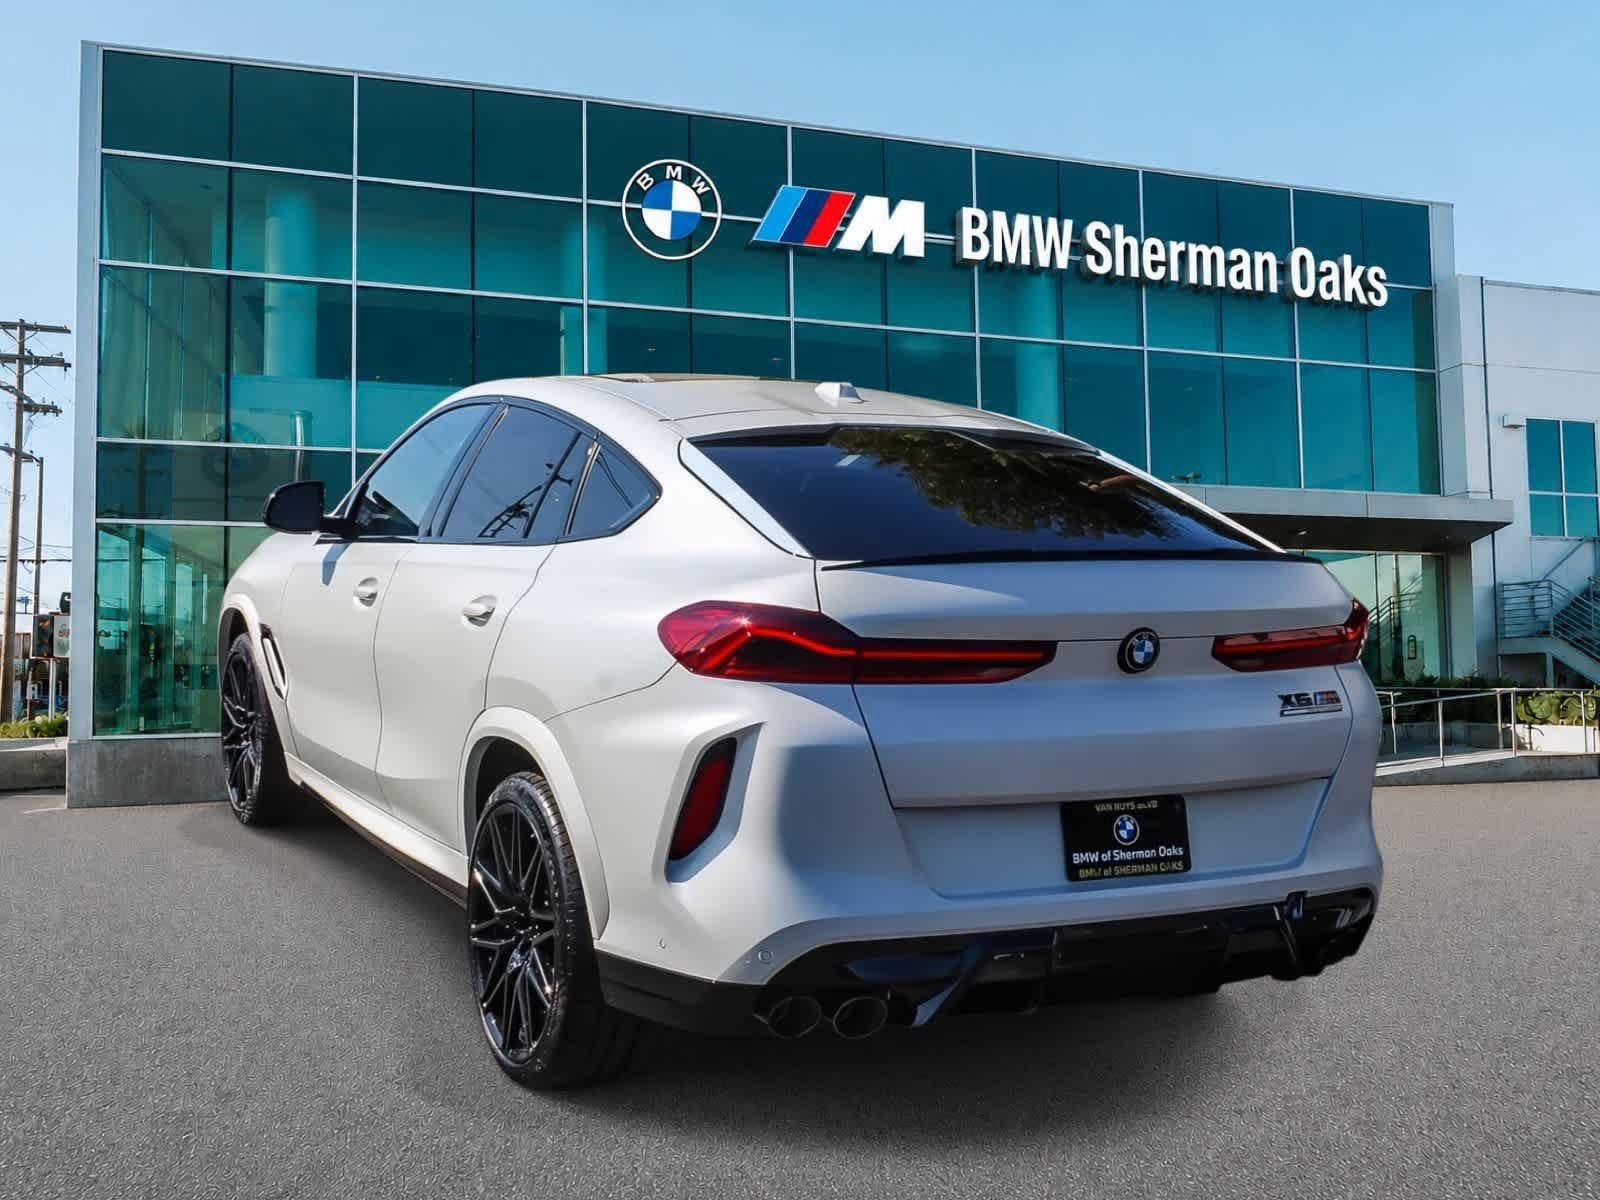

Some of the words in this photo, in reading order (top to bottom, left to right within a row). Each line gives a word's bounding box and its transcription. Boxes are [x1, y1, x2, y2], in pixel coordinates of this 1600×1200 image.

[636, 164, 711, 197] BMW
[961, 206, 1073, 270] BMW
[1085, 220, 1278, 294] Sherman
[1289, 247, 1388, 307] Oaks
[1073, 851, 1099, 864] BMW
[1101, 849, 1111, 861] of
[1112, 848, 1156, 861] Sherman
[1158, 845, 1183, 857] Oaks
[1079, 867, 1102, 878] BMW
[1113, 862, 1158, 876] SHERMAN
[1159, 860, 1184, 872] OAKS
